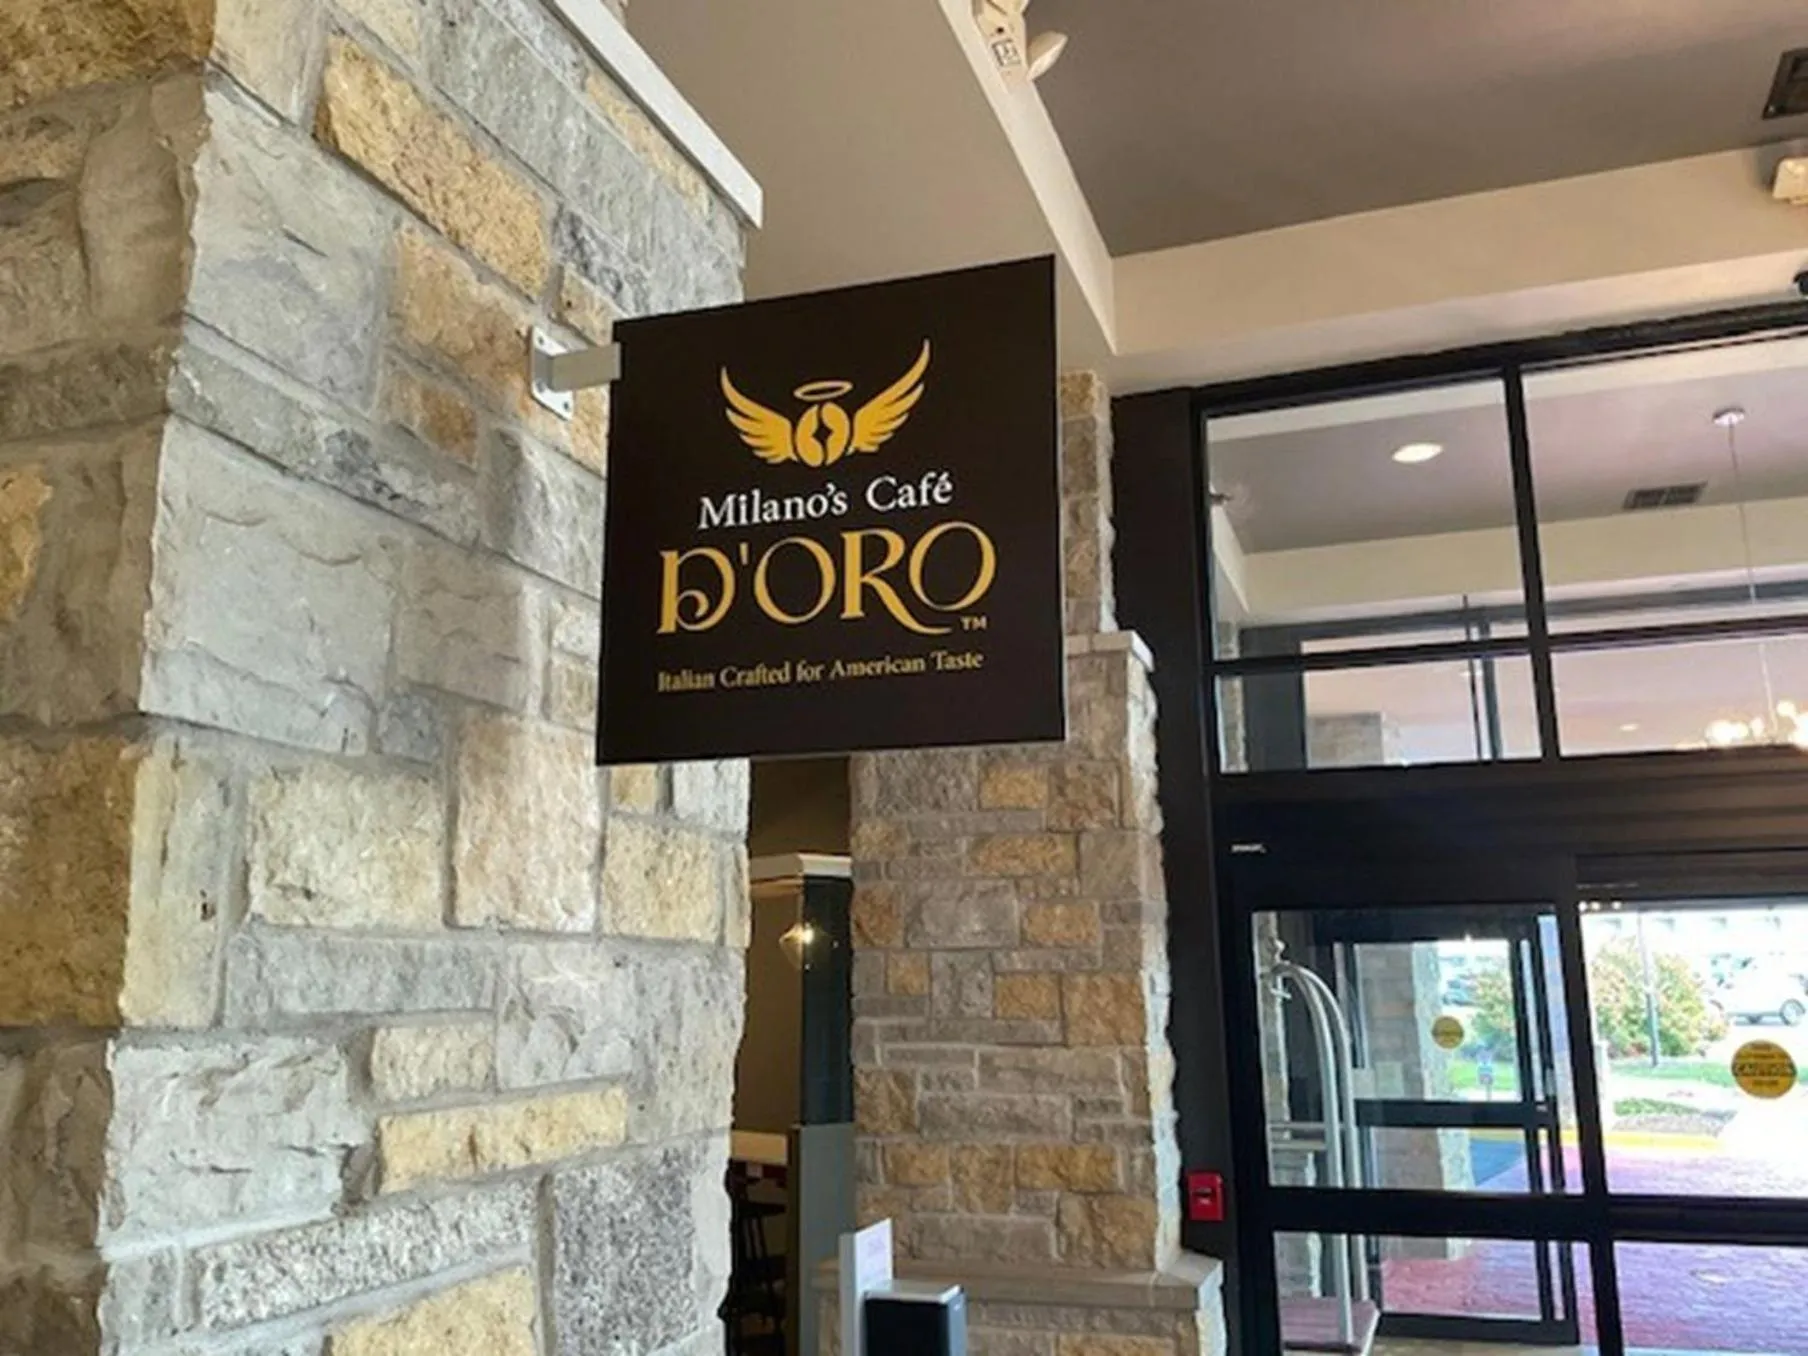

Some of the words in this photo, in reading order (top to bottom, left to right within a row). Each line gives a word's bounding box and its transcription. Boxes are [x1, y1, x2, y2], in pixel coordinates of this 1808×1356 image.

[698, 483, 848, 530] Milano's
[865, 471, 953, 512] Café
[656, 521, 996, 635] D'ORO
[961, 615, 987, 631] TM
[658, 669, 715, 692] Italian
[720, 660, 791, 688] Crafted
[796, 660, 824, 682] for
[830, 655, 926, 680] American
[929, 650, 984, 671] Taste
